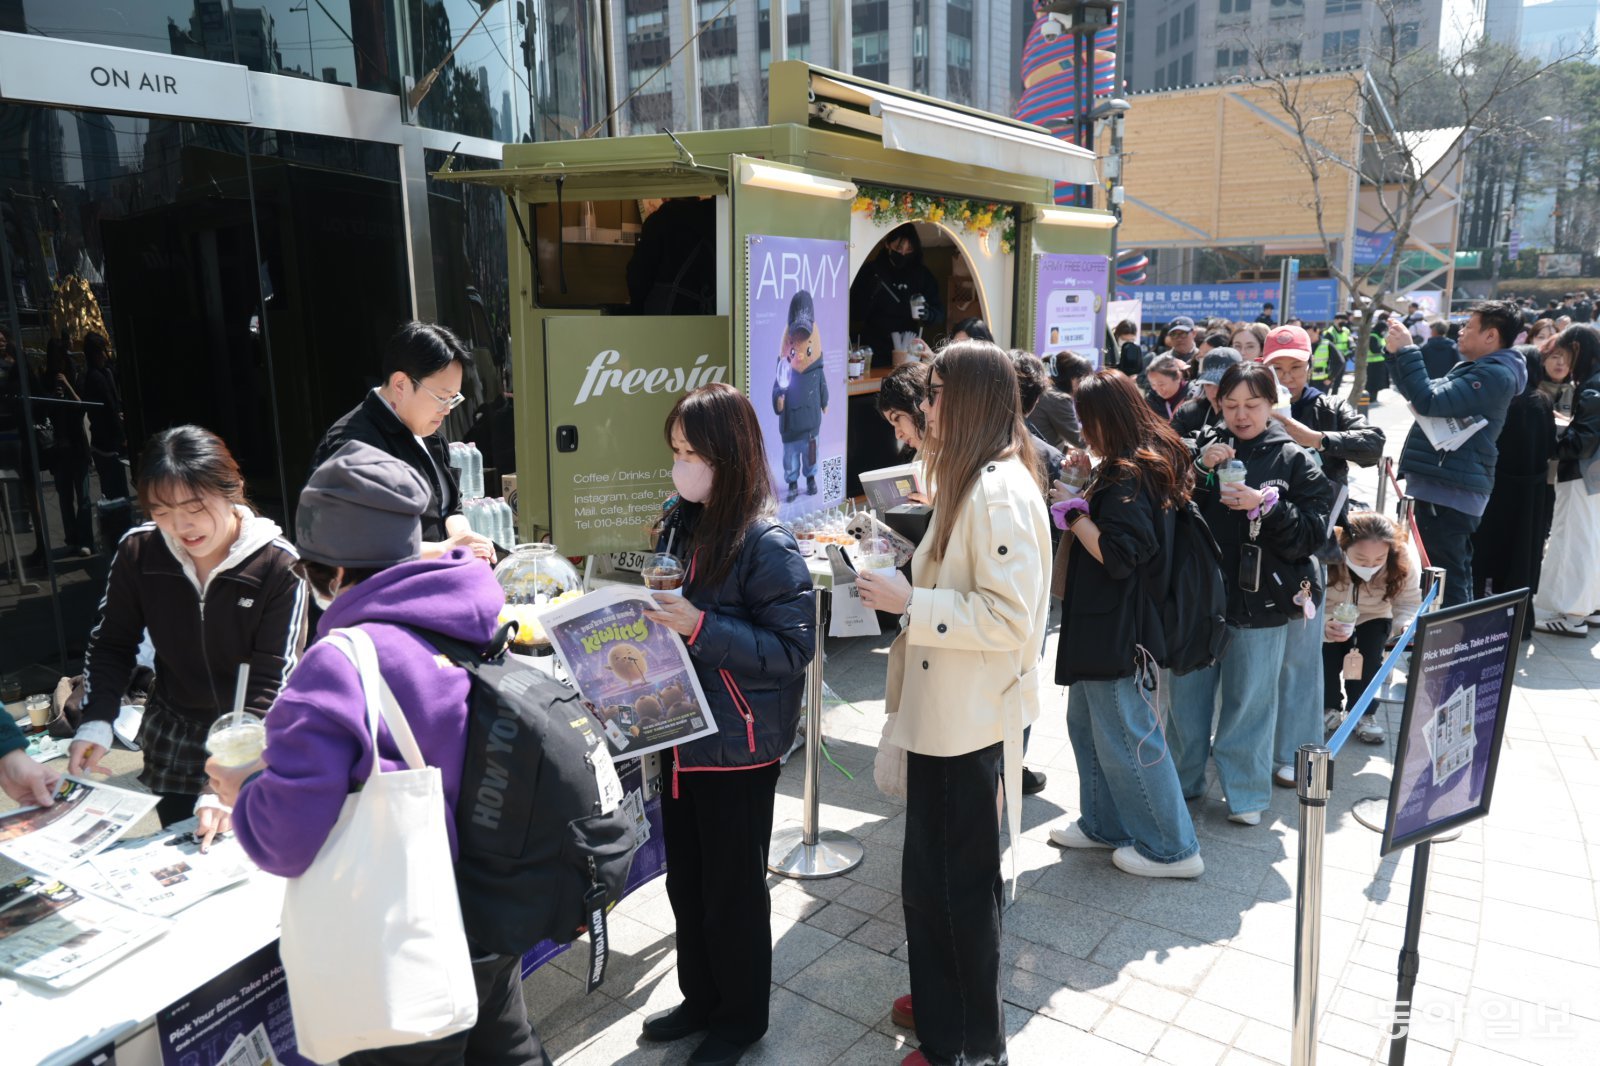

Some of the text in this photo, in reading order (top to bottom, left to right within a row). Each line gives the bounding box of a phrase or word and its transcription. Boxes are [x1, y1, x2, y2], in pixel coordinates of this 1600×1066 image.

[91, 67, 177, 94] ON AIR
[756, 252, 844, 300] ARMY
[574, 350, 727, 406] freesia
[574, 474, 609, 483] Coffee
[619, 471, 650, 481] Drinks
[574, 493, 628, 504] Instagram.
[1424, 632, 1508, 660] Pick Your Bias, Take It Home.
[472, 705, 522, 830] HOW YOU
[592, 909, 604, 935] HOW
[596, 934, 604, 955] YOU
[169, 1023, 192, 1044] Pick
[192, 1008, 216, 1026] Your
[216, 995, 239, 1013] Bias,
[240, 980, 261, 996] Take
[262, 974, 269, 982] It
[228, 1005, 242, 1016] from
[243, 997, 255, 1009] your
